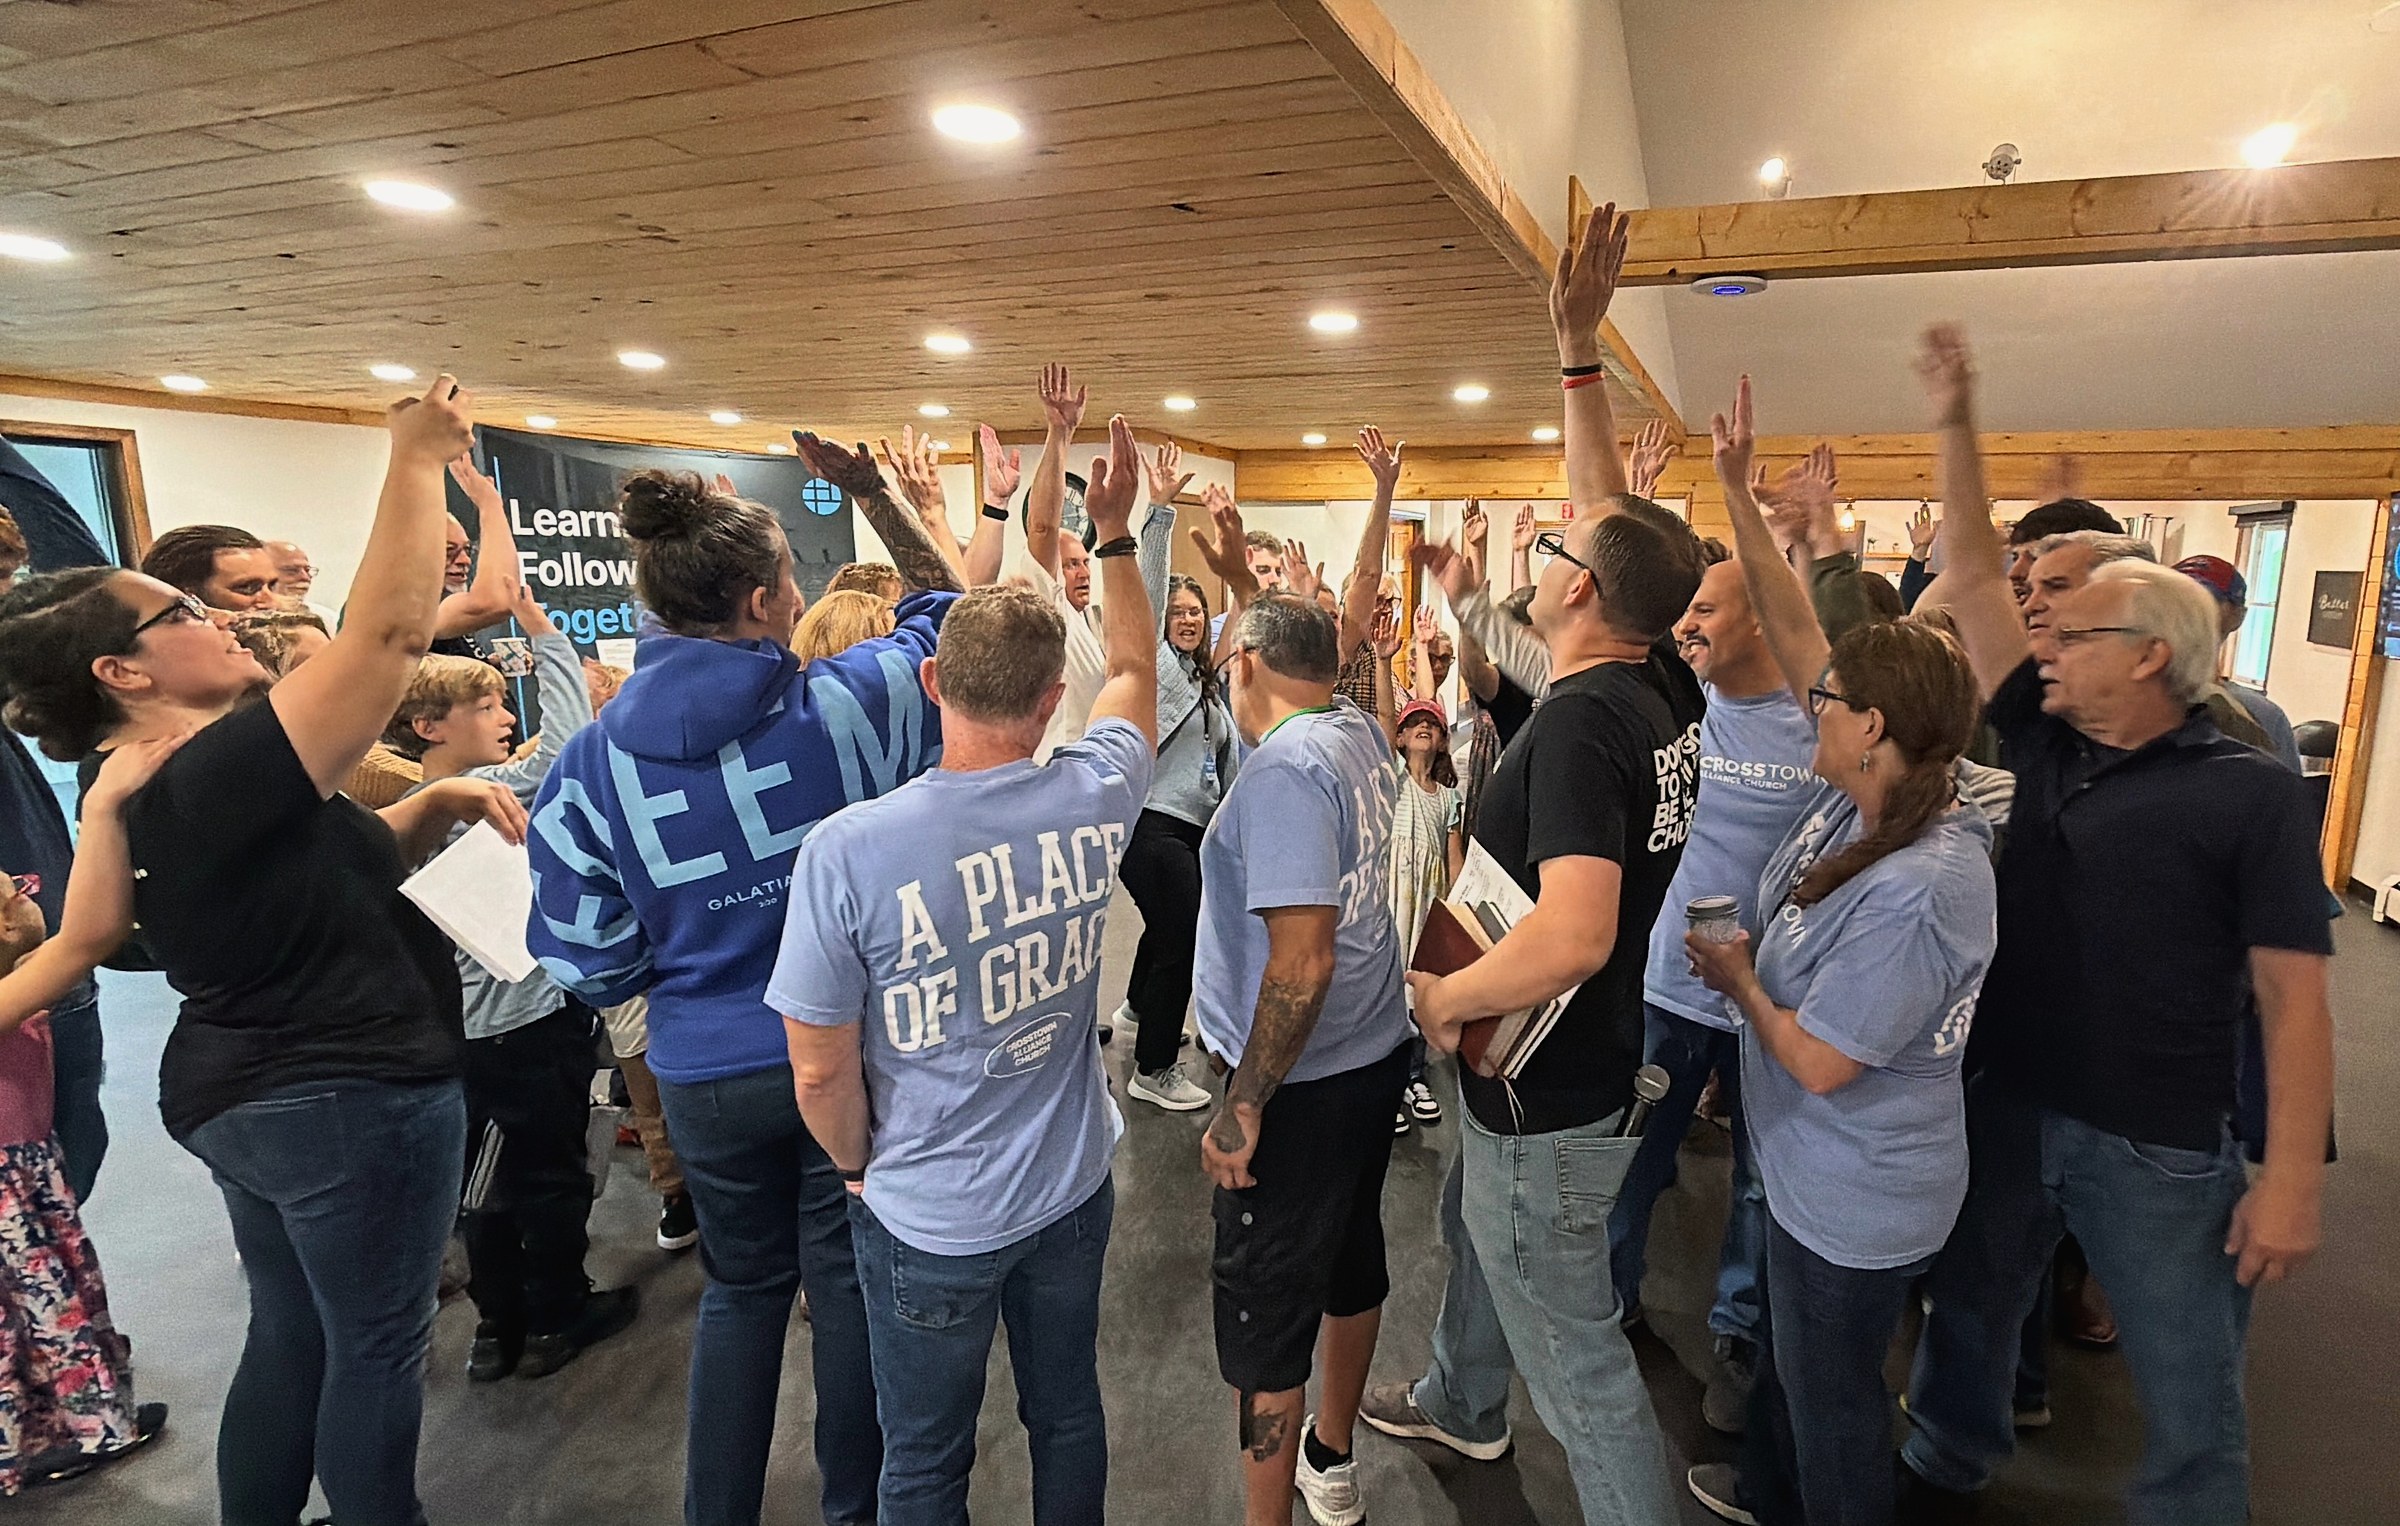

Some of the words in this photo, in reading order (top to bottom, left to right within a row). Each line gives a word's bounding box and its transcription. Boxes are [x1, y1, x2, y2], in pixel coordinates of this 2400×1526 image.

[509, 499, 632, 538] Learn
[1656, 771, 1680, 802] TO
[1744, 778, 1787, 790] CHURCH
[1652, 797, 1680, 829] BE
[896, 879, 948, 971] A
[883, 966, 957, 1053] OF
[1006, 1020, 1058, 1054] CROSSTOWN
[1012, 1033, 1053, 1061] ALLIANCE
[1014, 1043, 1051, 1067] CHURCH
